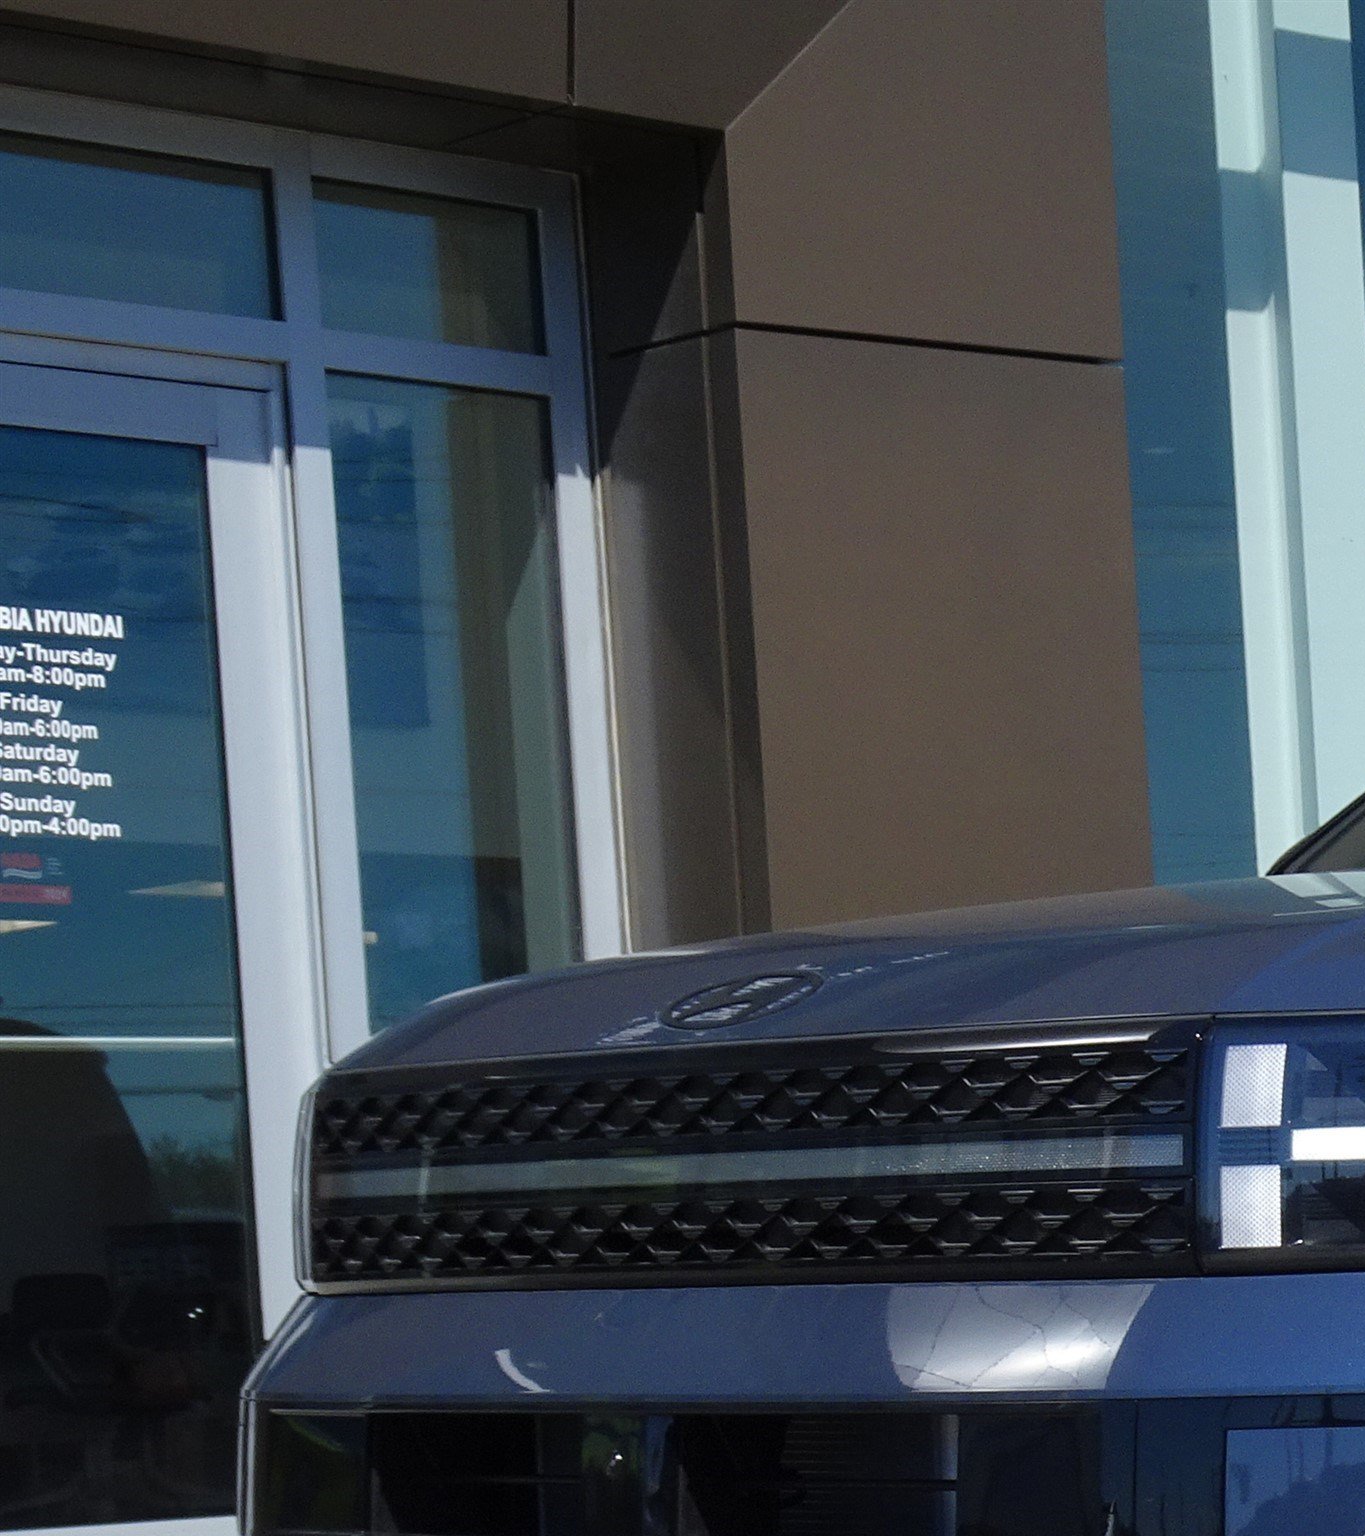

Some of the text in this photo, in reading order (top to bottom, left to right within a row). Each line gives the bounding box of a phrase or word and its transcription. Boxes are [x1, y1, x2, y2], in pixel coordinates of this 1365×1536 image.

[35, 608, 123, 638] HYUNDAI
[0, 691, 63, 718] Friday
[0, 719, 99, 742] am-6:00pm
[0, 743, 79, 766] aturday
[0, 765, 112, 790] am-6:00pm
[0, 792, 76, 817] Sunday
